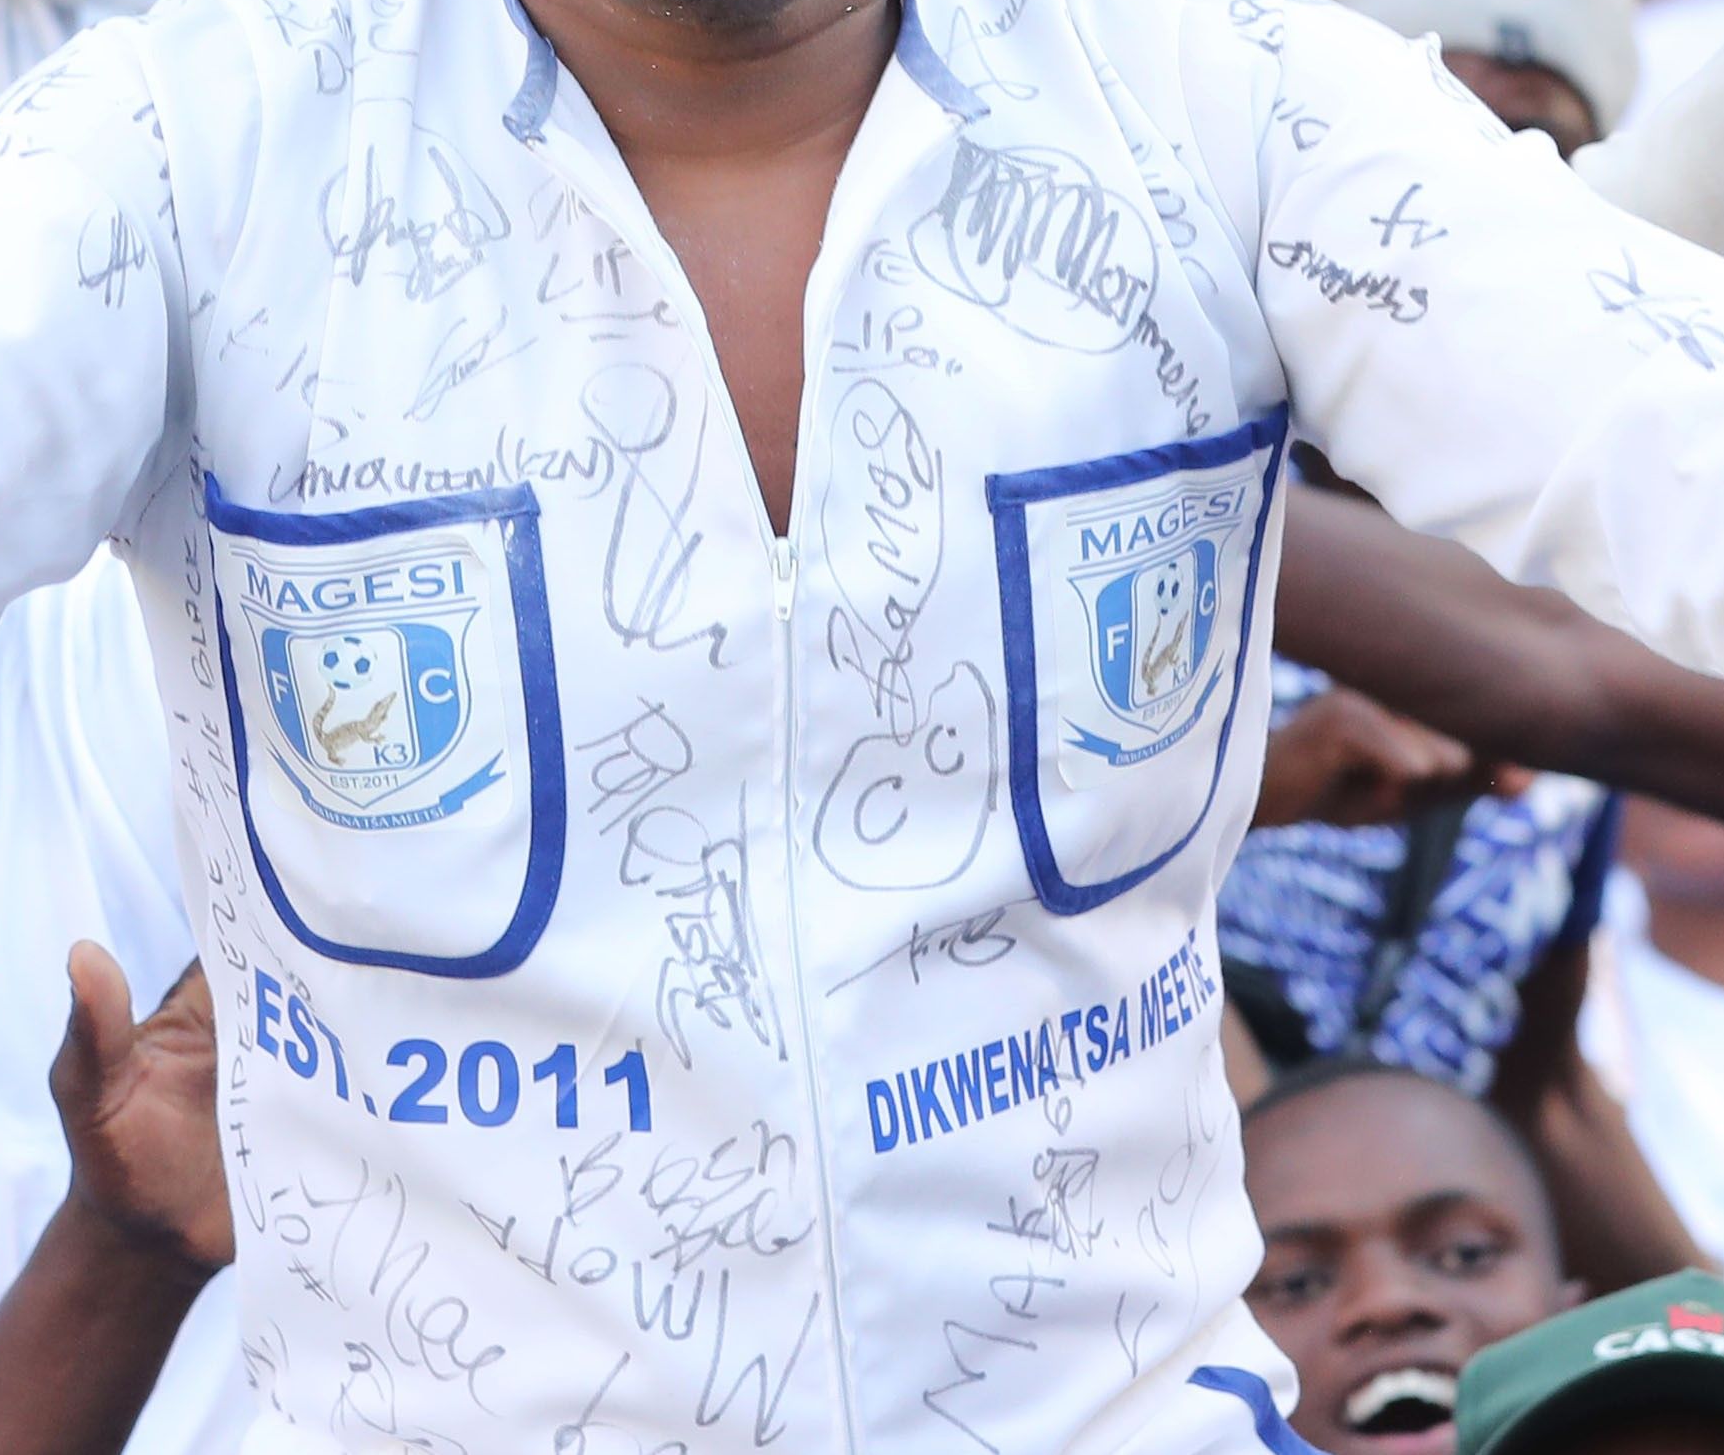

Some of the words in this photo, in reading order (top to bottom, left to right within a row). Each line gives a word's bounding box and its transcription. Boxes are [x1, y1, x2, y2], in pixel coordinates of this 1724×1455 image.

[1080, 485, 1247, 562] MAGESI
[243, 559, 466, 613] MAGESI
[1106, 622, 1129, 662] F
[1198, 582, 1215, 617] C
[270, 669, 291, 703] F
[417, 667, 455, 705] C
[330, 773, 400, 790] EST.2011
[373, 744, 408, 767] K3
[865, 1034, 1060, 1155] DIKWENA
[1060, 996, 1132, 1073] TSA
